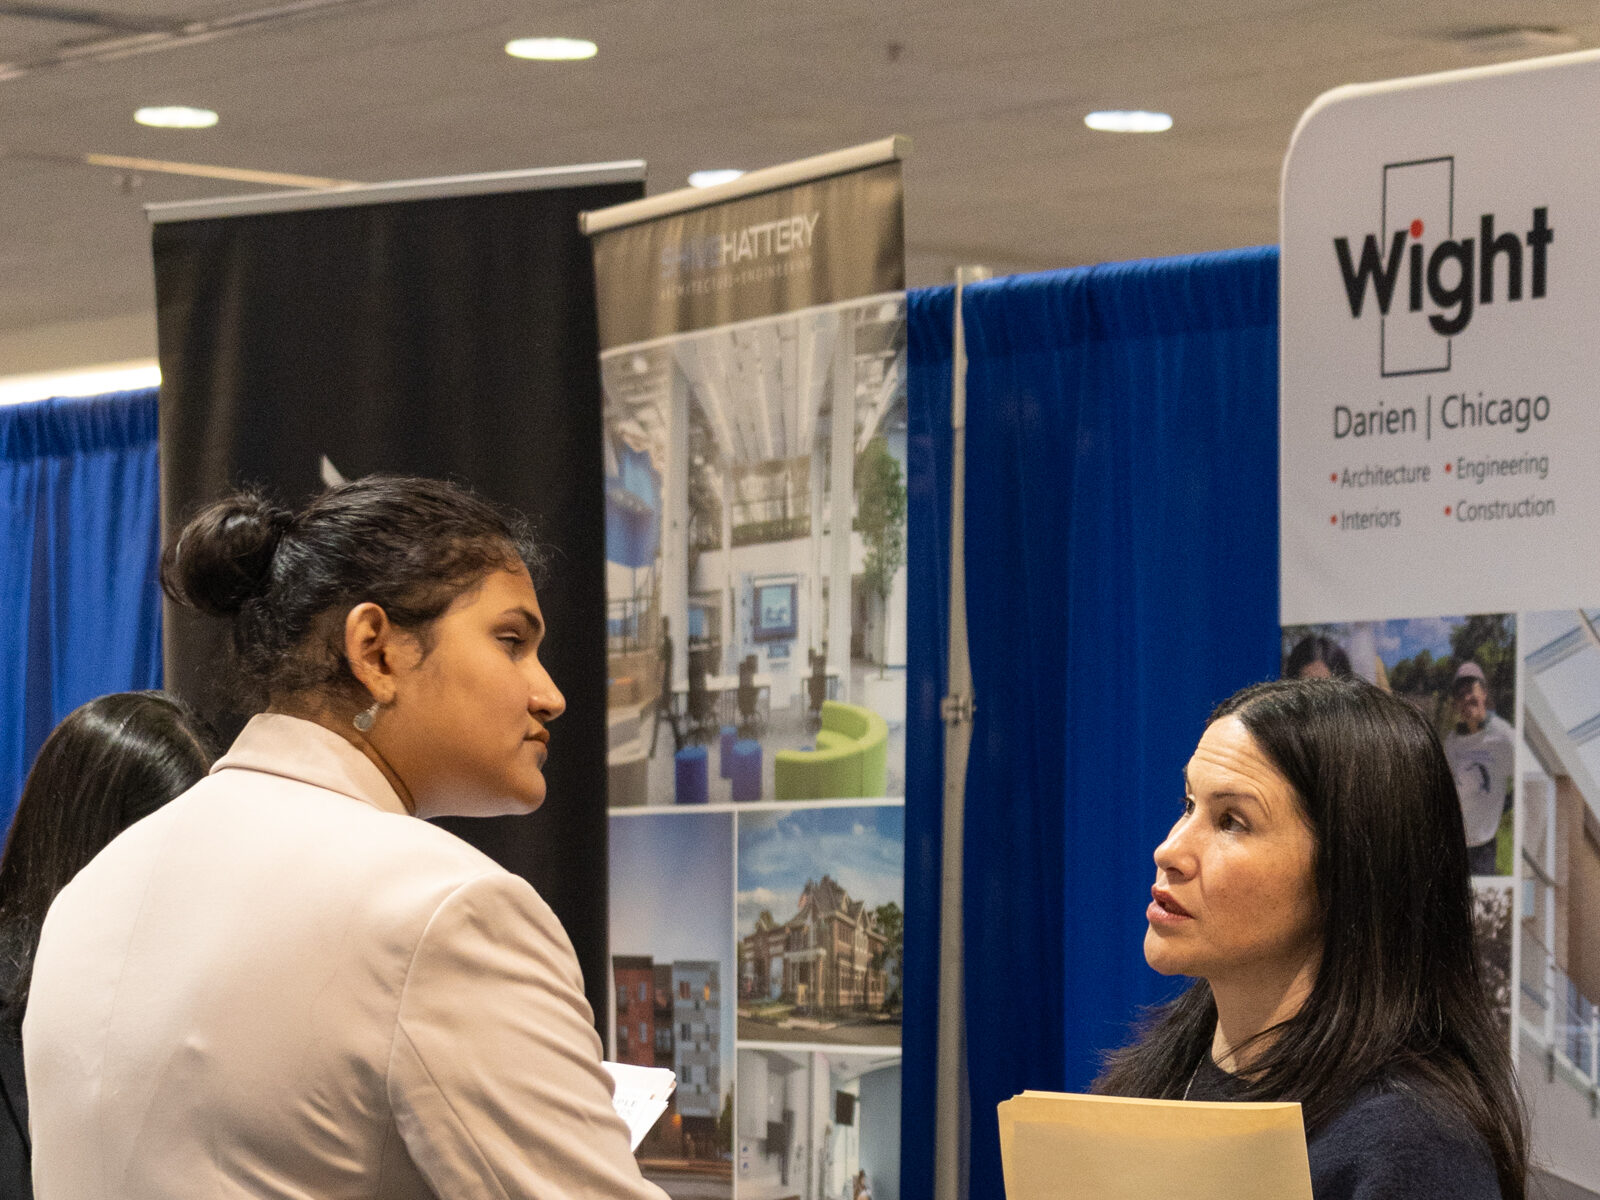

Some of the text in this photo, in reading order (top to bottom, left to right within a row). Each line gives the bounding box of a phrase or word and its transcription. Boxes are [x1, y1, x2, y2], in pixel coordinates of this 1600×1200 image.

[1334, 206, 1554, 337] Wight
[1334, 401, 1417, 439] Darien
[1441, 391, 1551, 433] Chicago
[1341, 463, 1432, 489] Architecture
[1456, 453, 1549, 485] Engineering
[1341, 507, 1401, 530] Interiors
[1456, 494, 1556, 523] Construction
